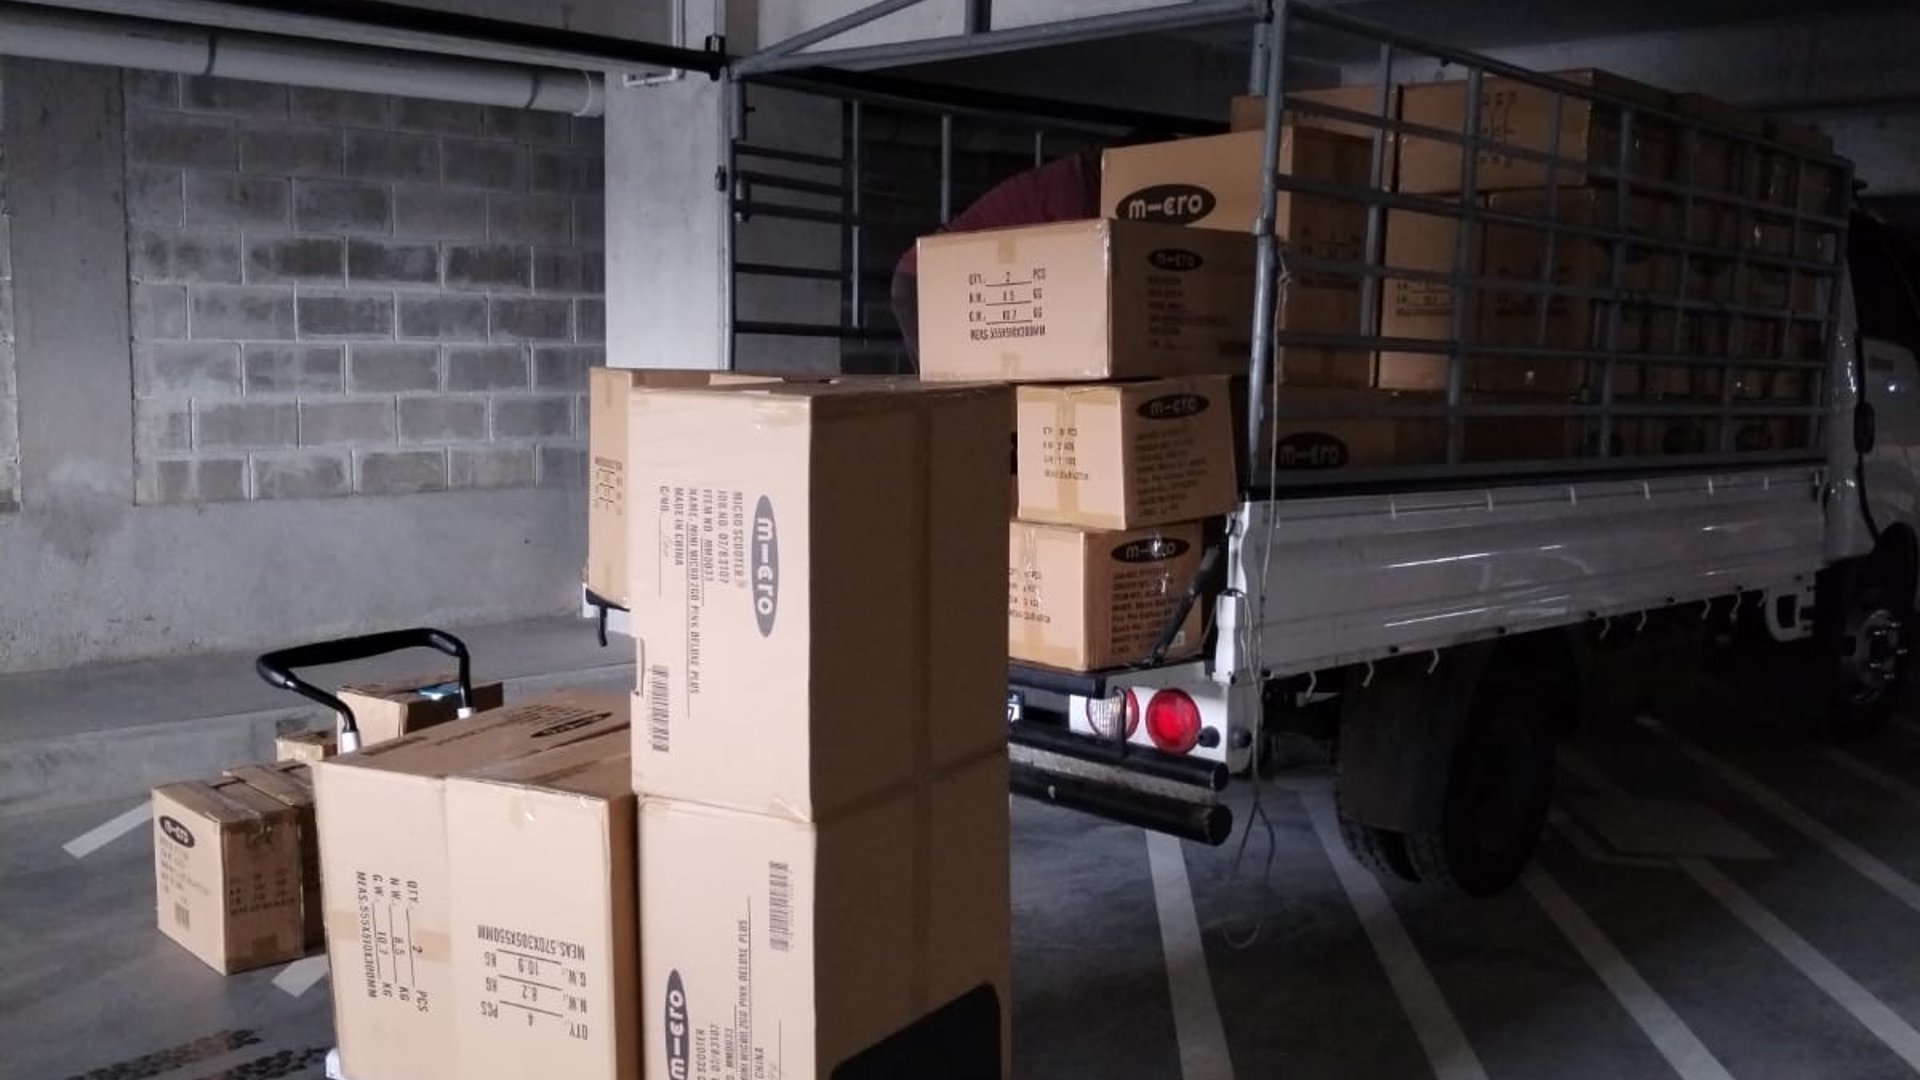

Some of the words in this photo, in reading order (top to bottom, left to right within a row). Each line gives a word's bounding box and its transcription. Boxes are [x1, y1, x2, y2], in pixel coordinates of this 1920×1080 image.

[674, 487, 685, 516] MADE
[703, 489, 714, 515] ITEM
[717, 489, 729, 509] JOB
[733, 491, 745, 527] MICRO
[674, 519, 685, 531] IN
[689, 524, 700, 547] MINI
[674, 533, 685, 566] CHINA
[733, 528, 745, 578] SCOOTER
[689, 549, 700, 579] MICRO
[690, 605, 700, 628] PINK
[690, 631, 700, 666] DELUXE
[690, 670, 700, 694] PLUS
[738, 920, 749, 945] PLUS
[377, 931, 389, 955] 10.7
[383, 981, 393, 997] KG
[484, 951, 497, 967] KG
[518, 958, 539, 977] 10.9
[738, 948, 749, 982] DELUXE
[399, 986, 410, 1002] KG
[486, 977, 498, 992] KG
[522, 985, 538, 1002] 8.2
[738, 985, 748, 1008] PINK
[415, 990, 428, 1012] PCS
[480, 1001, 499, 1019] PCS
[695, 1028, 706, 1073] SCOOTER
[753, 1046, 765, 1079] CHINA
